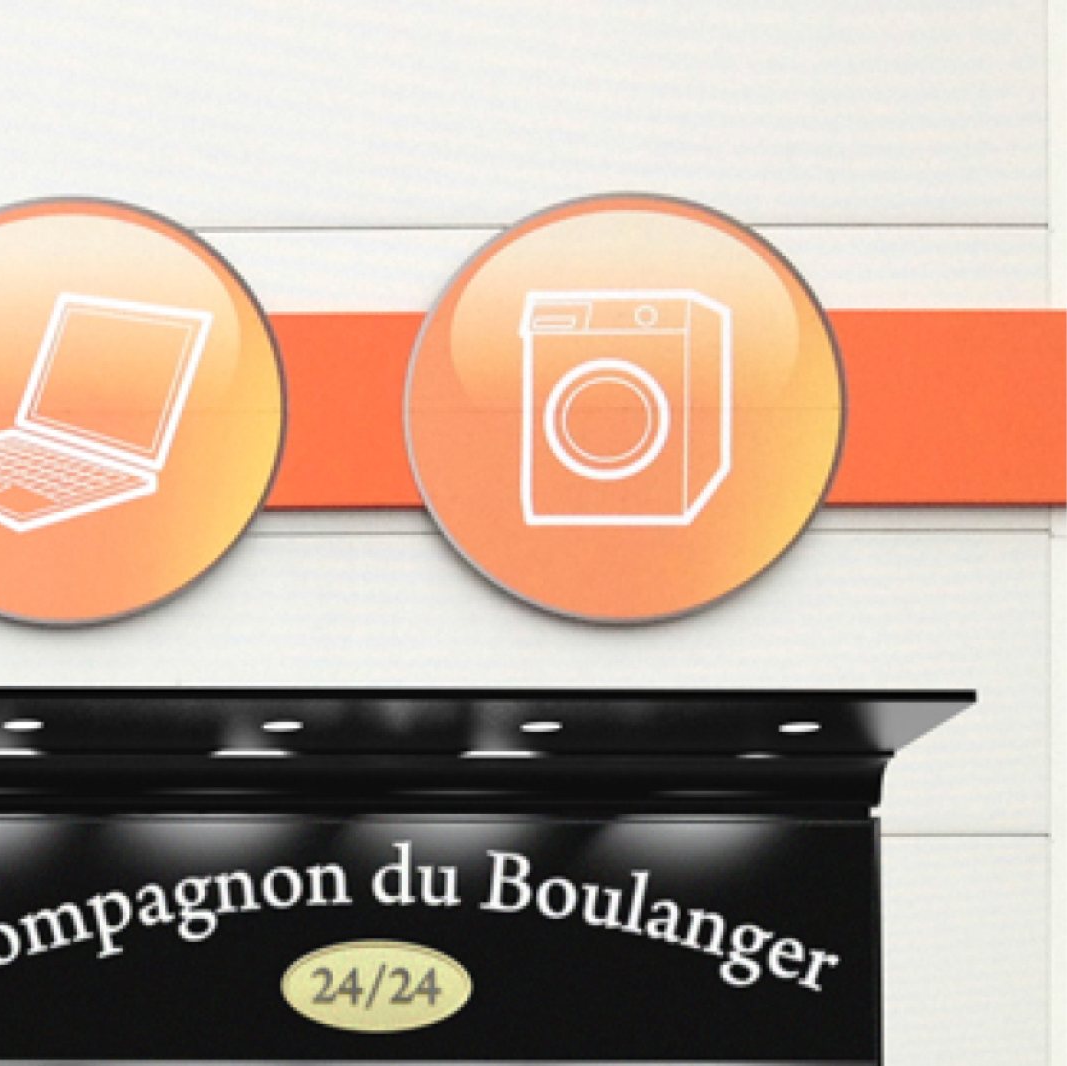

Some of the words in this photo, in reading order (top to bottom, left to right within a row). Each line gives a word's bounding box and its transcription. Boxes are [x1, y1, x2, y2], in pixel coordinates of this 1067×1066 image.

[371, 839, 462, 906] du
[479, 849, 840, 992] Boulanger
[310, 961, 442, 1011] 24/24
